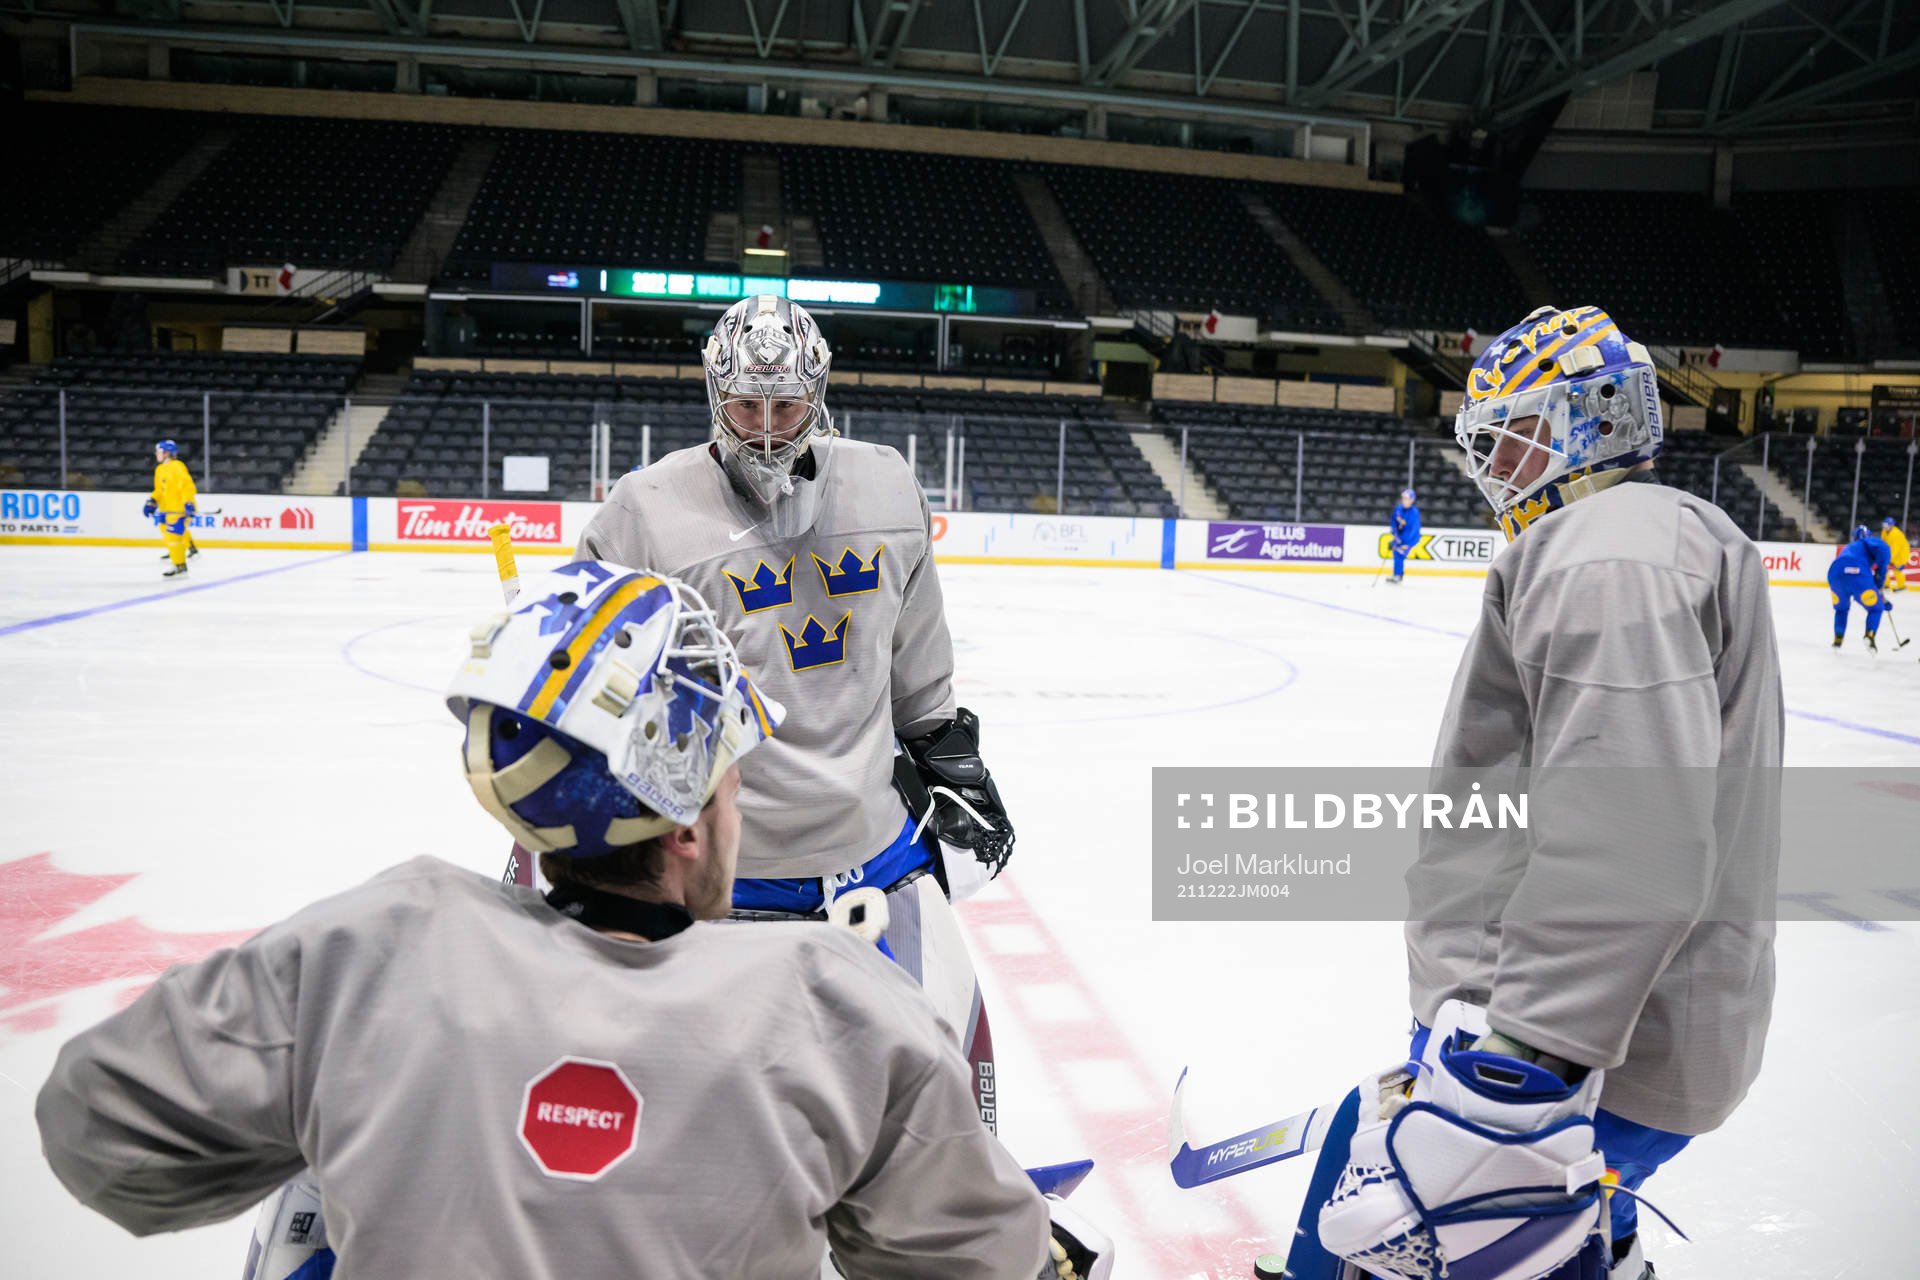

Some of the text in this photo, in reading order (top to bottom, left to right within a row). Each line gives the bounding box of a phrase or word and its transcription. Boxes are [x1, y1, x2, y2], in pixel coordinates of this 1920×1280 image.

[745, 364, 791, 374] BAUER
[1642, 371, 1661, 438] BAUER
[21, 524, 60, 533] PARTS
[222, 516, 273, 529] MART
[401, 505, 450, 538] Tim
[1262, 526, 1306, 541] TELUS
[1259, 541, 1342, 560] Agriculture
[1444, 540, 1490, 558] TIRE
[627, 772, 685, 819] BAUER
[537, 1102, 625, 1131] RESPECT
[1207, 1127, 1289, 1167] HYPERLITE
